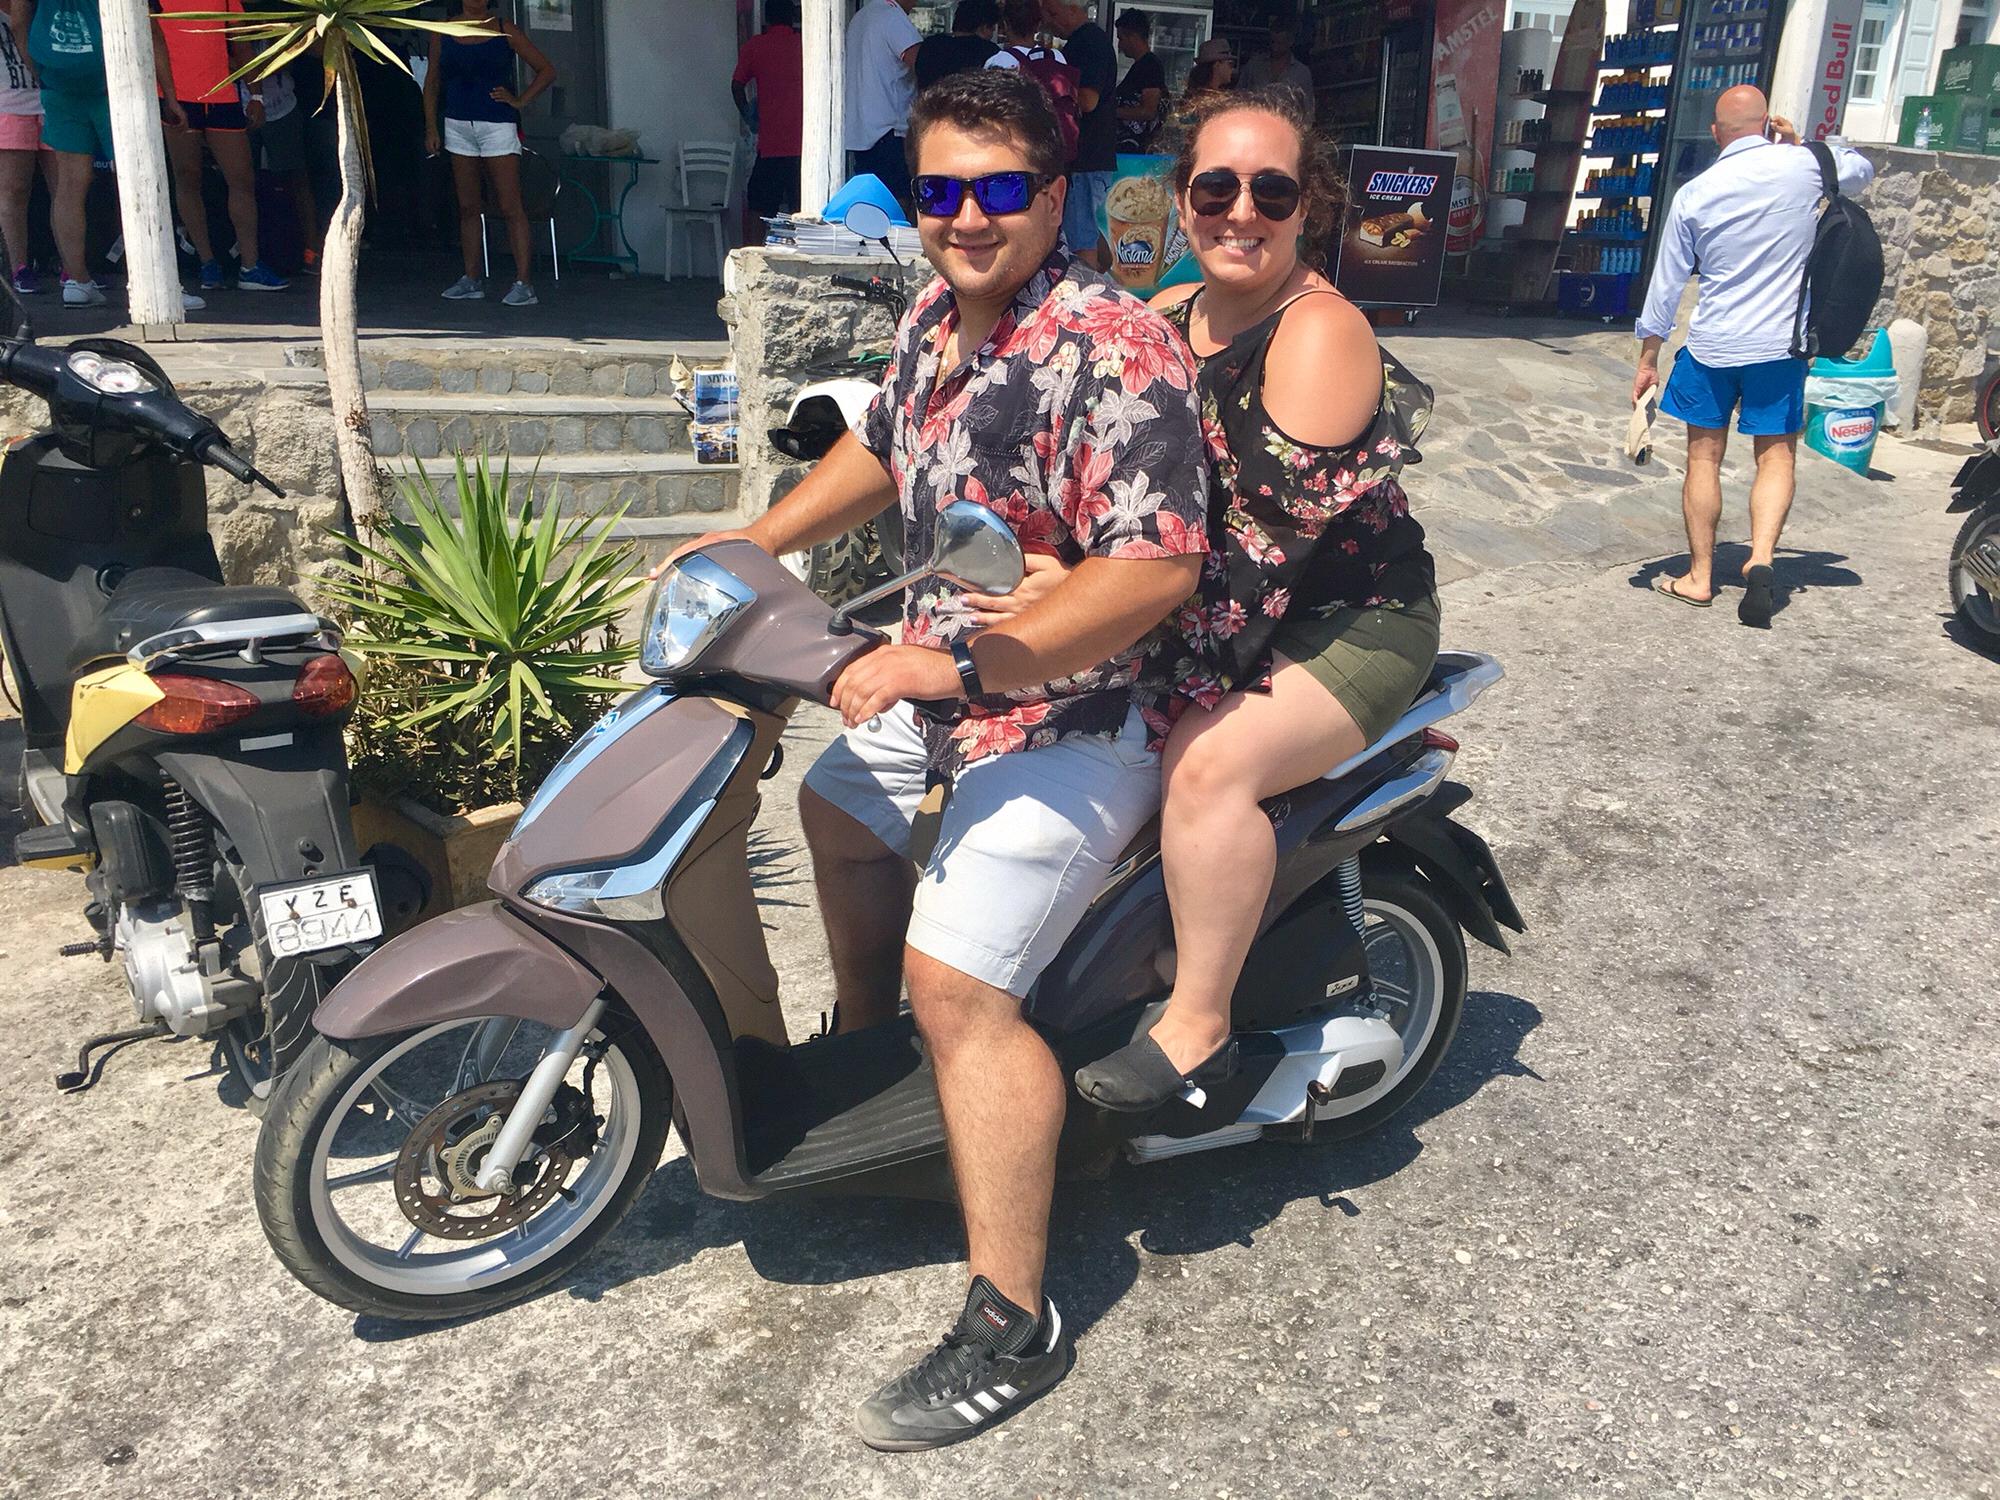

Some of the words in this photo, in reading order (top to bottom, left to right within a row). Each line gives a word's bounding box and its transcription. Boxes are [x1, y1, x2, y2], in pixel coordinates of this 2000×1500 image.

[1435, 6, 1498, 61] AMSTEL
[1826, 23, 1852, 80] Bull
[1815, 84, 1841, 141] Red
[1368, 172, 1436, 195] SNICKERS
[1117, 236, 1157, 264] Nirvana
[707, 374, 737, 384] MYKO
[1832, 421, 1873, 438] Nestlé
[984, 1306, 1008, 1327] adidas
